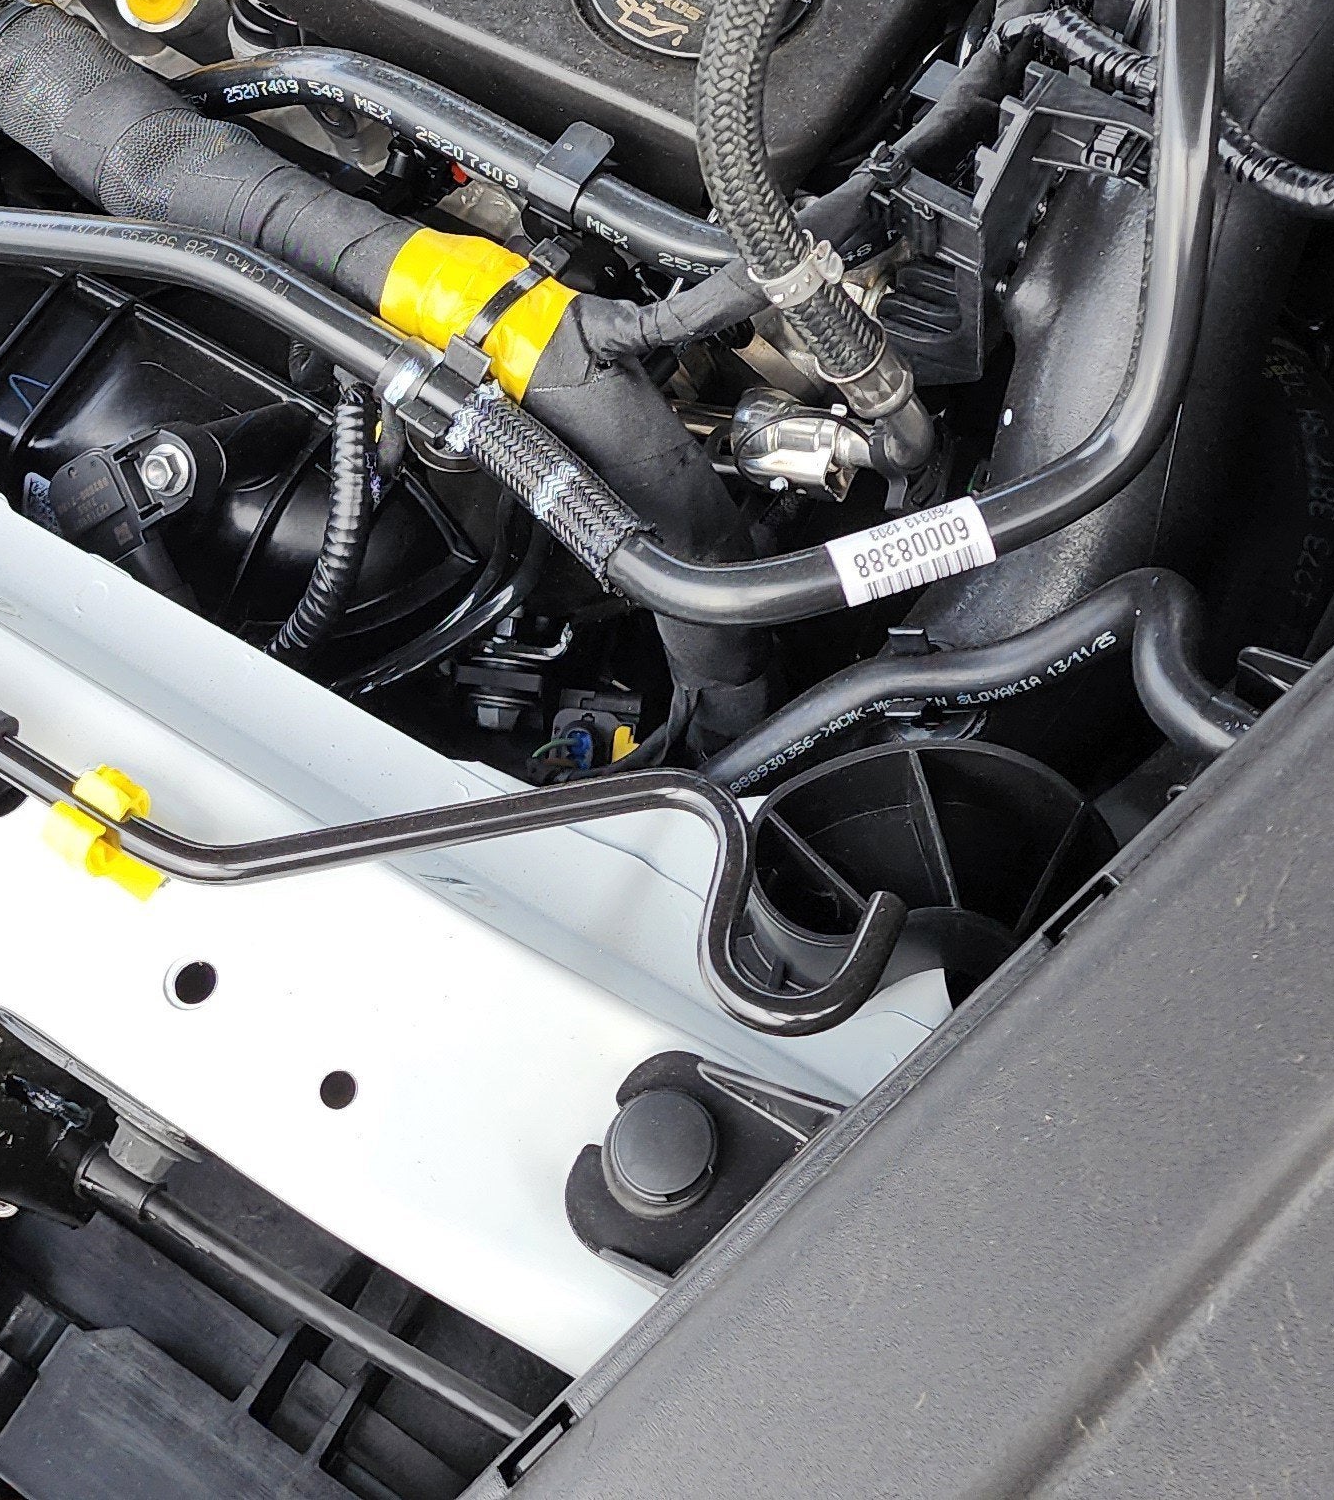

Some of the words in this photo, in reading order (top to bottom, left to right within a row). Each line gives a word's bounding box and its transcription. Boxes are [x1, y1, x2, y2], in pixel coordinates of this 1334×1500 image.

[223, 79, 299, 103] 25207409
[353, 93, 393, 125] MEX
[414, 126, 520, 191] 25207409
[586, 215, 629, 249] MEX
[853, 516, 970, 578] 60008388
[869, 522, 902, 542] 1203
[1046, 630, 1118, 677] 13/11/25
